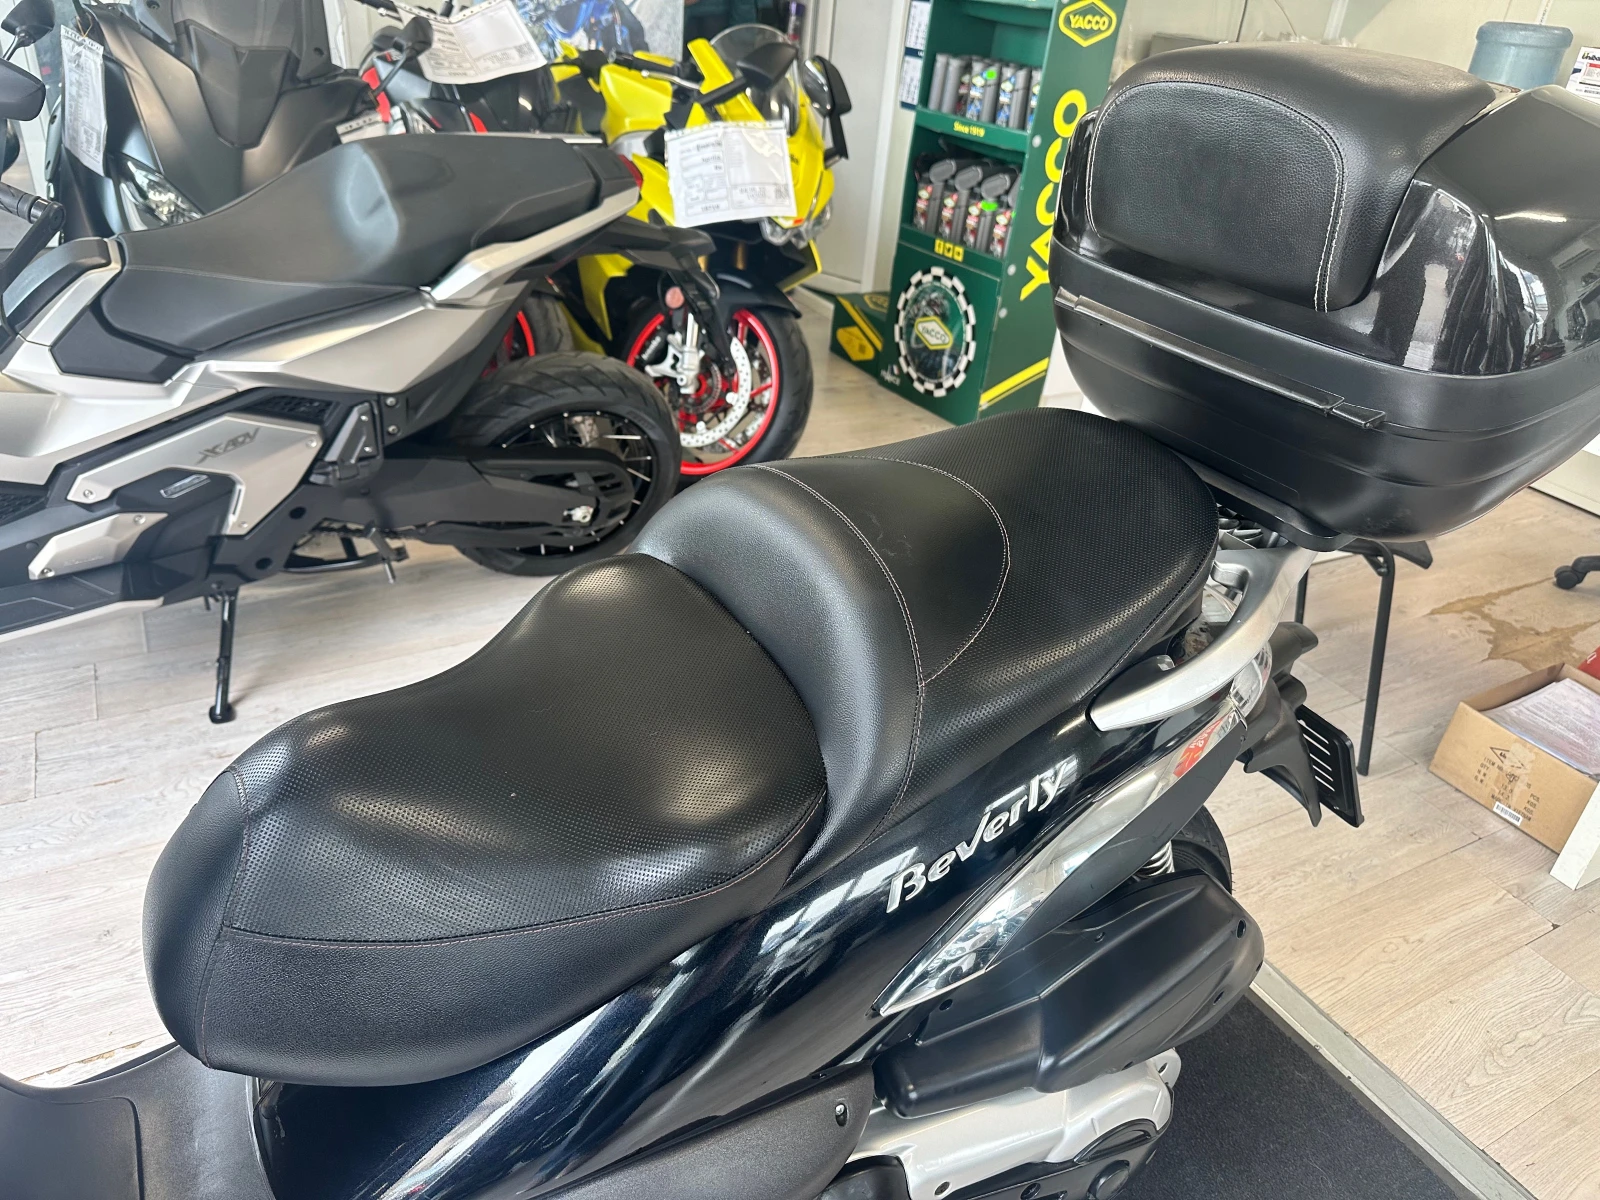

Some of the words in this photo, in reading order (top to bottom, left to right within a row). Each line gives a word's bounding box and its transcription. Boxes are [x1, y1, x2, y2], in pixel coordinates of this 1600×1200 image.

[1069, 14, 1109, 31] YACCO
[953, 120, 969, 134] Since
[969, 124, 985, 138] 1919
[920, 324, 948, 344] YACCO
[886, 762, 1067, 913] Beverly
